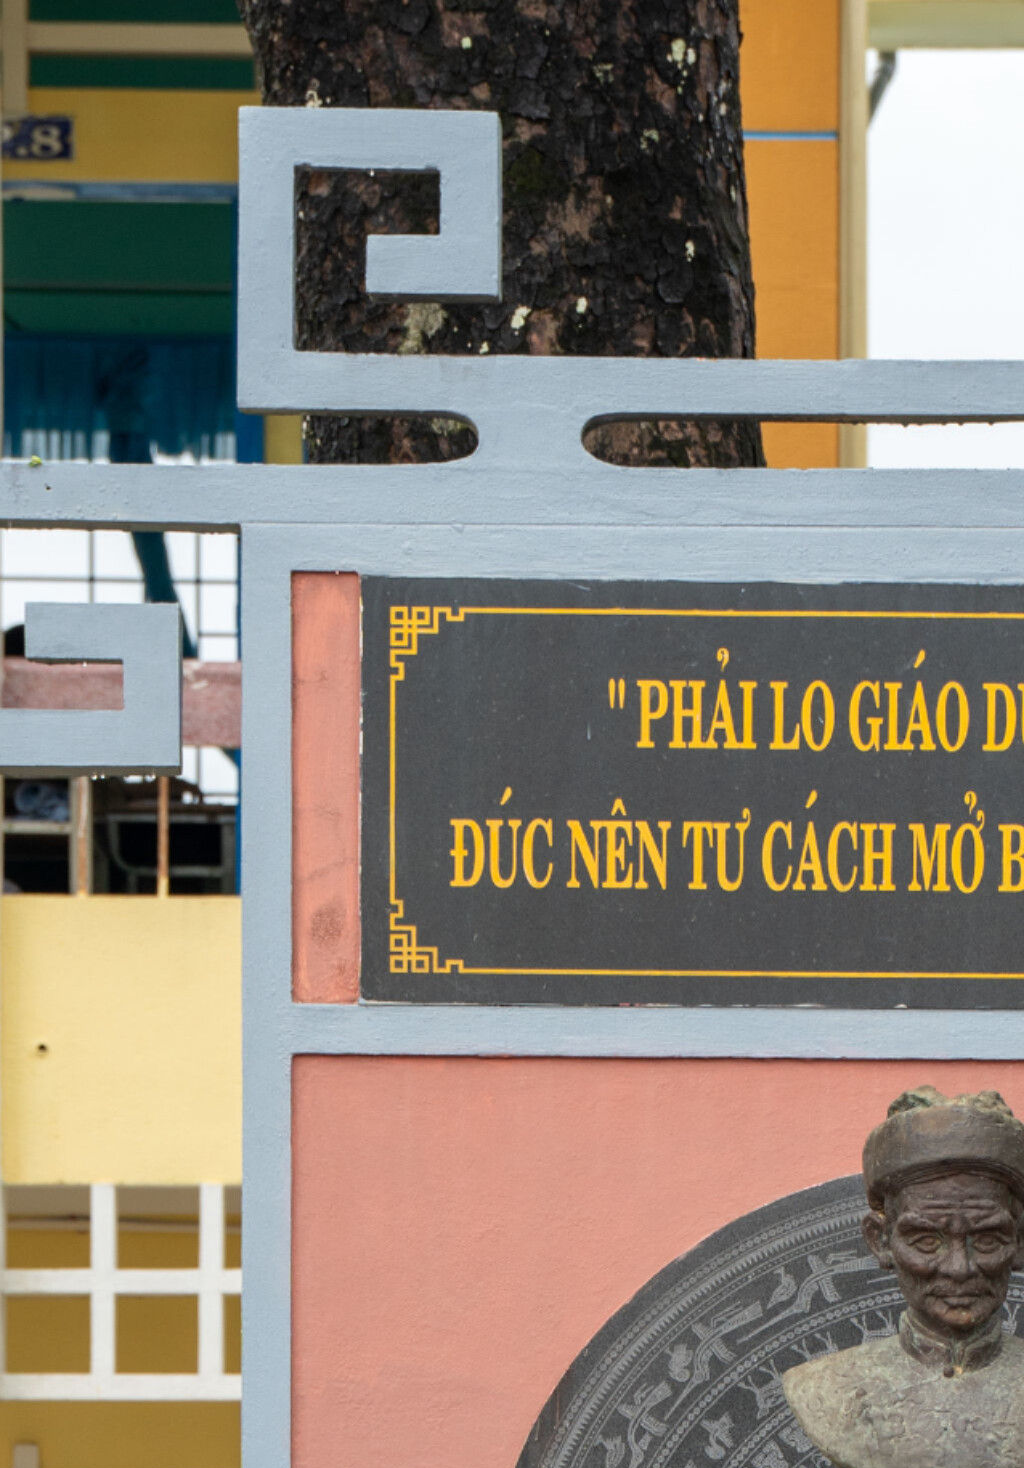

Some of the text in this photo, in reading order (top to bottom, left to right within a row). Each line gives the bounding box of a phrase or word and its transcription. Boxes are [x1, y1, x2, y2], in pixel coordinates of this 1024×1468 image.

[770, 680, 837, 753] LO
[849, 651, 971, 754] GIÁO
[451, 788, 554, 891] ĐÚC
[567, 799, 673, 891] NÊN
[683, 808, 752, 893] TƯ
[762, 791, 898, 894] CÁCH
[908, 791, 986, 895] MỞ
